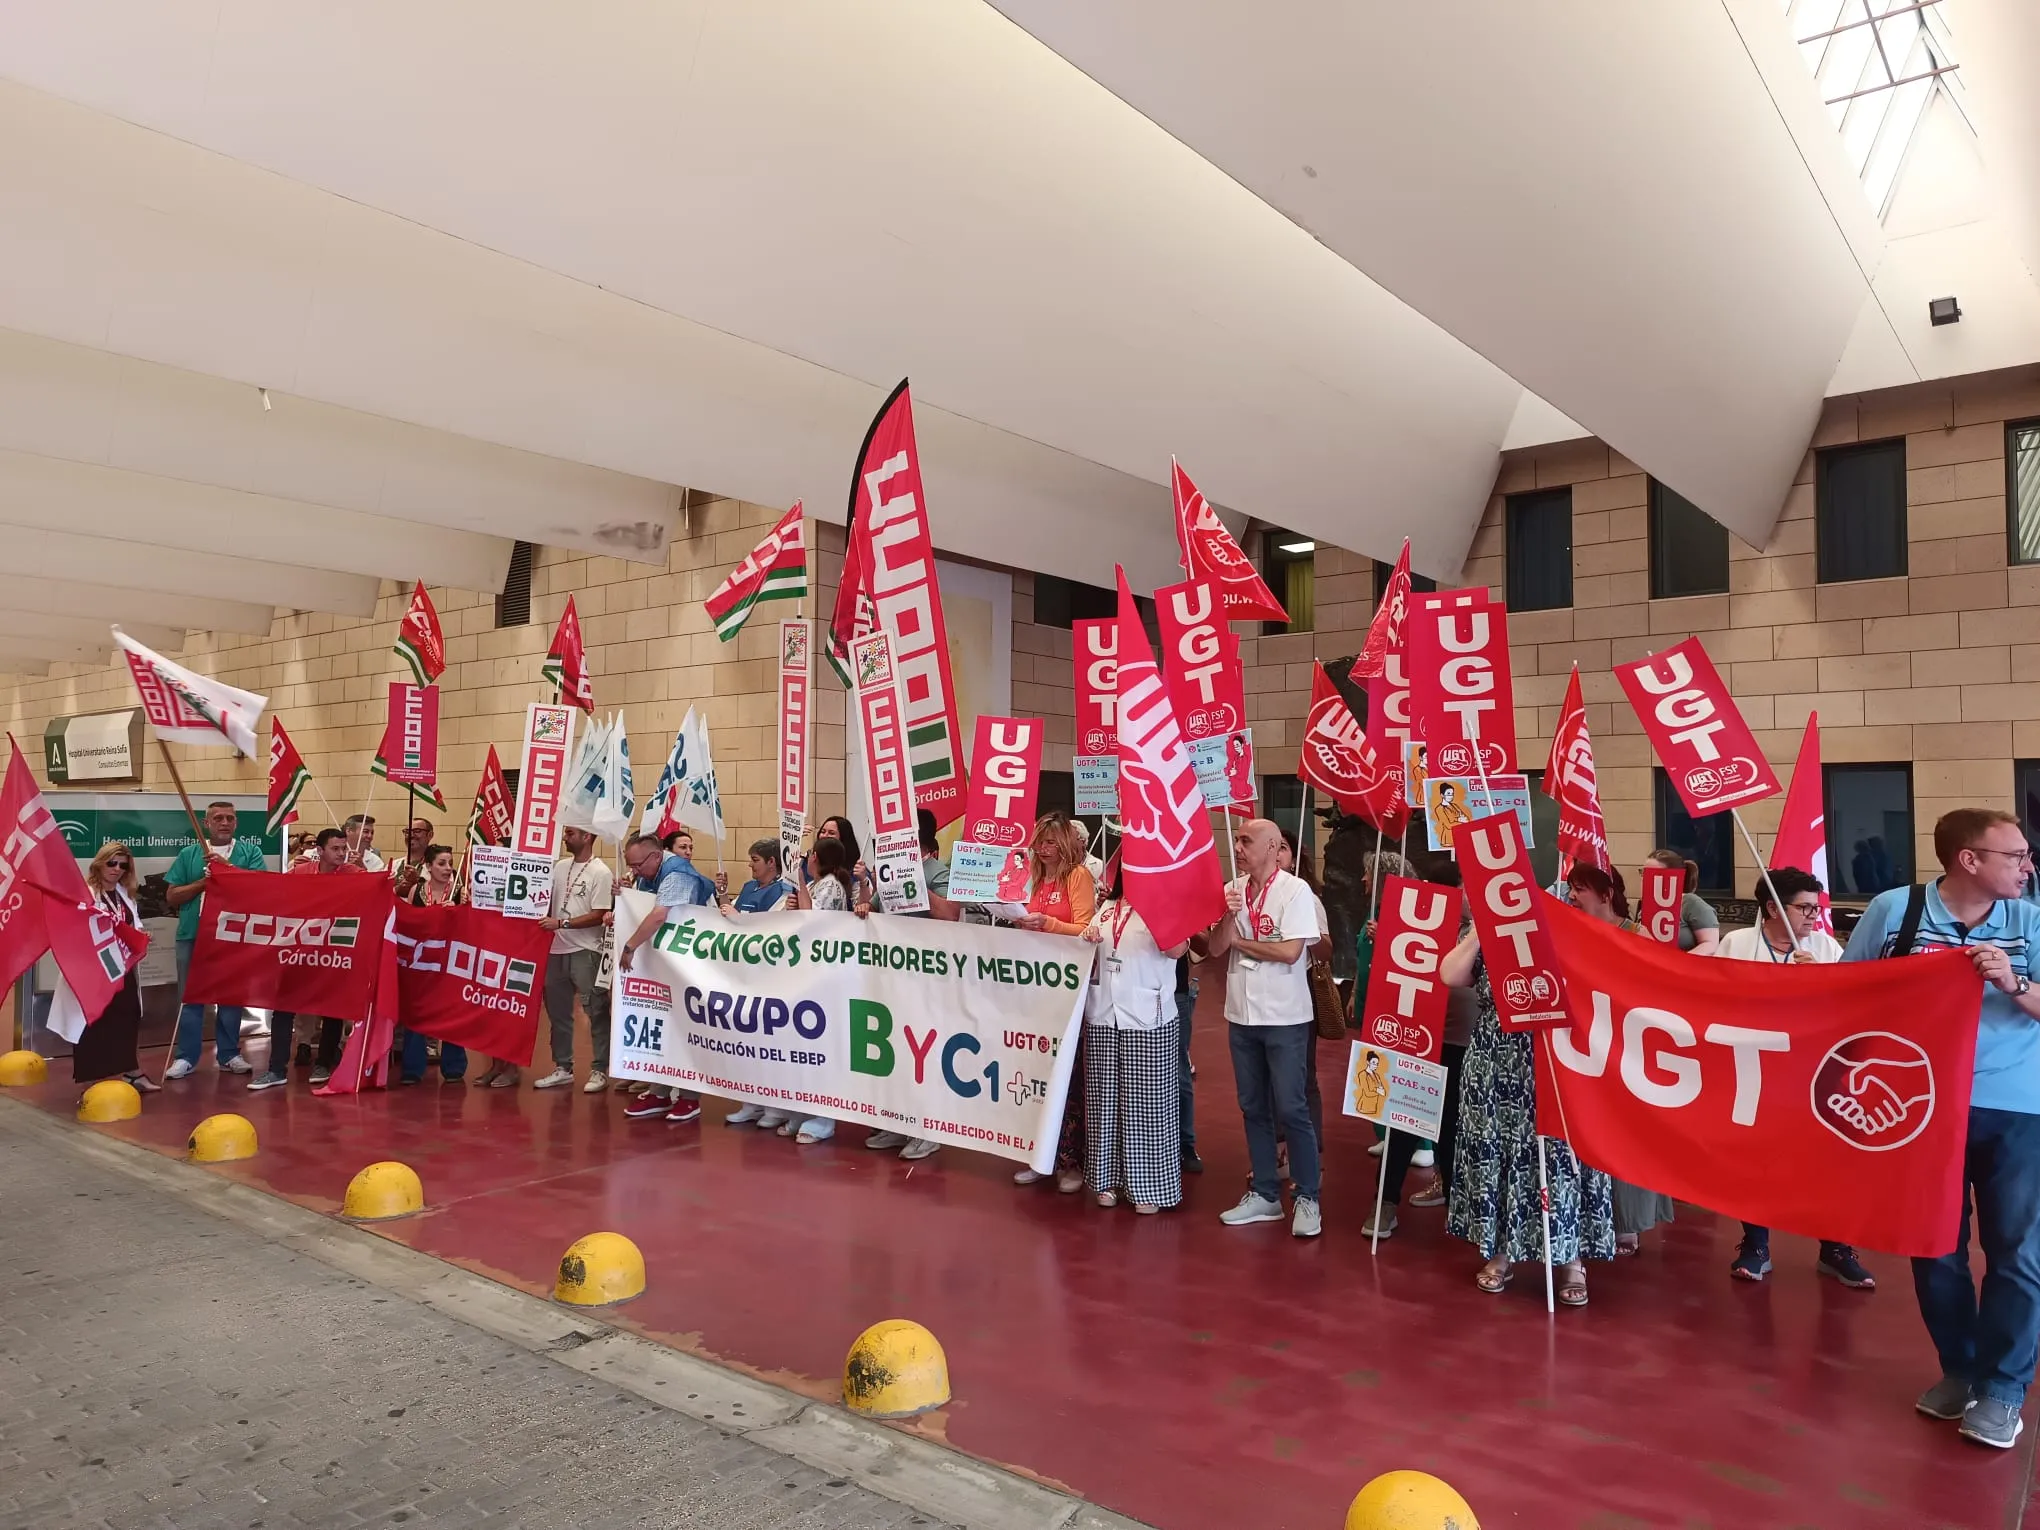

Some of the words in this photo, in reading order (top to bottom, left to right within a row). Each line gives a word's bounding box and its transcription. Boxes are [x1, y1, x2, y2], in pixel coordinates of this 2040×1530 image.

[864, 449, 947, 721] CCOO
[1172, 582, 1224, 705] UGT
[1437, 612, 1496, 740] UGT
[404, 685, 424, 752] CCOO
[1189, 713, 1209, 729] UGT
[1211, 709, 1226, 721] FSP
[1634, 652, 1726, 763] UGT
[786, 683, 801, 804] CCOO
[1088, 733, 1104, 743] UGT
[1108, 733, 1118, 742] FS
[869, 697, 903, 824] CCOO
[1077, 759, 1091, 767] UGT
[1443, 749, 1467, 762] UGT
[1475, 749, 1493, 759] SP
[983, 723, 1031, 819] UGT
[1688, 770, 1714, 788] UGT
[1719, 764, 1739, 777] FSP
[525, 752, 556, 849] CCOO
[914, 787, 957, 805] órdoba
[782, 830, 800, 846] GRUP
[975, 822, 996, 837] UGT
[1000, 825, 1016, 835] FSP
[474, 854, 509, 864] RECLASIFICAC
[957, 845, 974, 853] UGT
[511, 862, 550, 874] GRUPO
[960, 858, 977, 866] TSS
[507, 874, 528, 901] B
[903, 880, 917, 900] B
[952, 887, 968, 895] UGT
[1471, 822, 1539, 968] UGT
[1651, 875, 1677, 943] UG
[215, 910, 331, 947] CCOO
[278, 949, 353, 970] Córdoba
[653, 918, 801, 967] TÉCNIC@S
[810, 939, 949, 976] SUPERIORES
[952, 953, 968, 978] Y
[977, 955, 1080, 990] MEDIOS
[1386, 887, 1448, 1018] UGT
[628, 981, 664, 998] CCOO
[1506, 978, 1527, 996] UGT
[462, 984, 528, 1018] Córdoba
[684, 985, 827, 1040] GRUPO
[1376, 1018, 1399, 1038] UGT
[1404, 1027, 1421, 1039] FSP
[687, 1032, 756, 1058] APLICACIÓN
[758, 1048, 786, 1063] DEL
[790, 1051, 826, 1067] EBEP
[849, 998, 896, 1077] B
[904, 1025, 937, 1084] Y
[941, 1032, 1000, 1102] C1
[1003, 1030, 1036, 1052] UGT
[1398, 1058, 1415, 1070] UGT
[1552, 990, 1791, 1127] UGT
[1391, 1075, 1419, 1090] TCAE
[643, 1062, 697, 1081] SALARIALES
[698, 1072, 705, 1082] Y
[705, 1075, 755, 1094] LABORALES
[756, 1086, 779, 1098] CON
[781, 1089, 793, 1100] EL
[795, 1091, 858, 1112] DESARROLLO
[860, 1102, 878, 1116] DEL
[880, 1109, 899, 1120] GRUPO
[923, 1117, 994, 1142] ESTABLECIDO
[996, 1132, 1011, 1146] EN
[1013, 1136, 1026, 1150] EL
[1027, 1139, 1036, 1152] A
[1391, 1112, 1408, 1123] UGT
